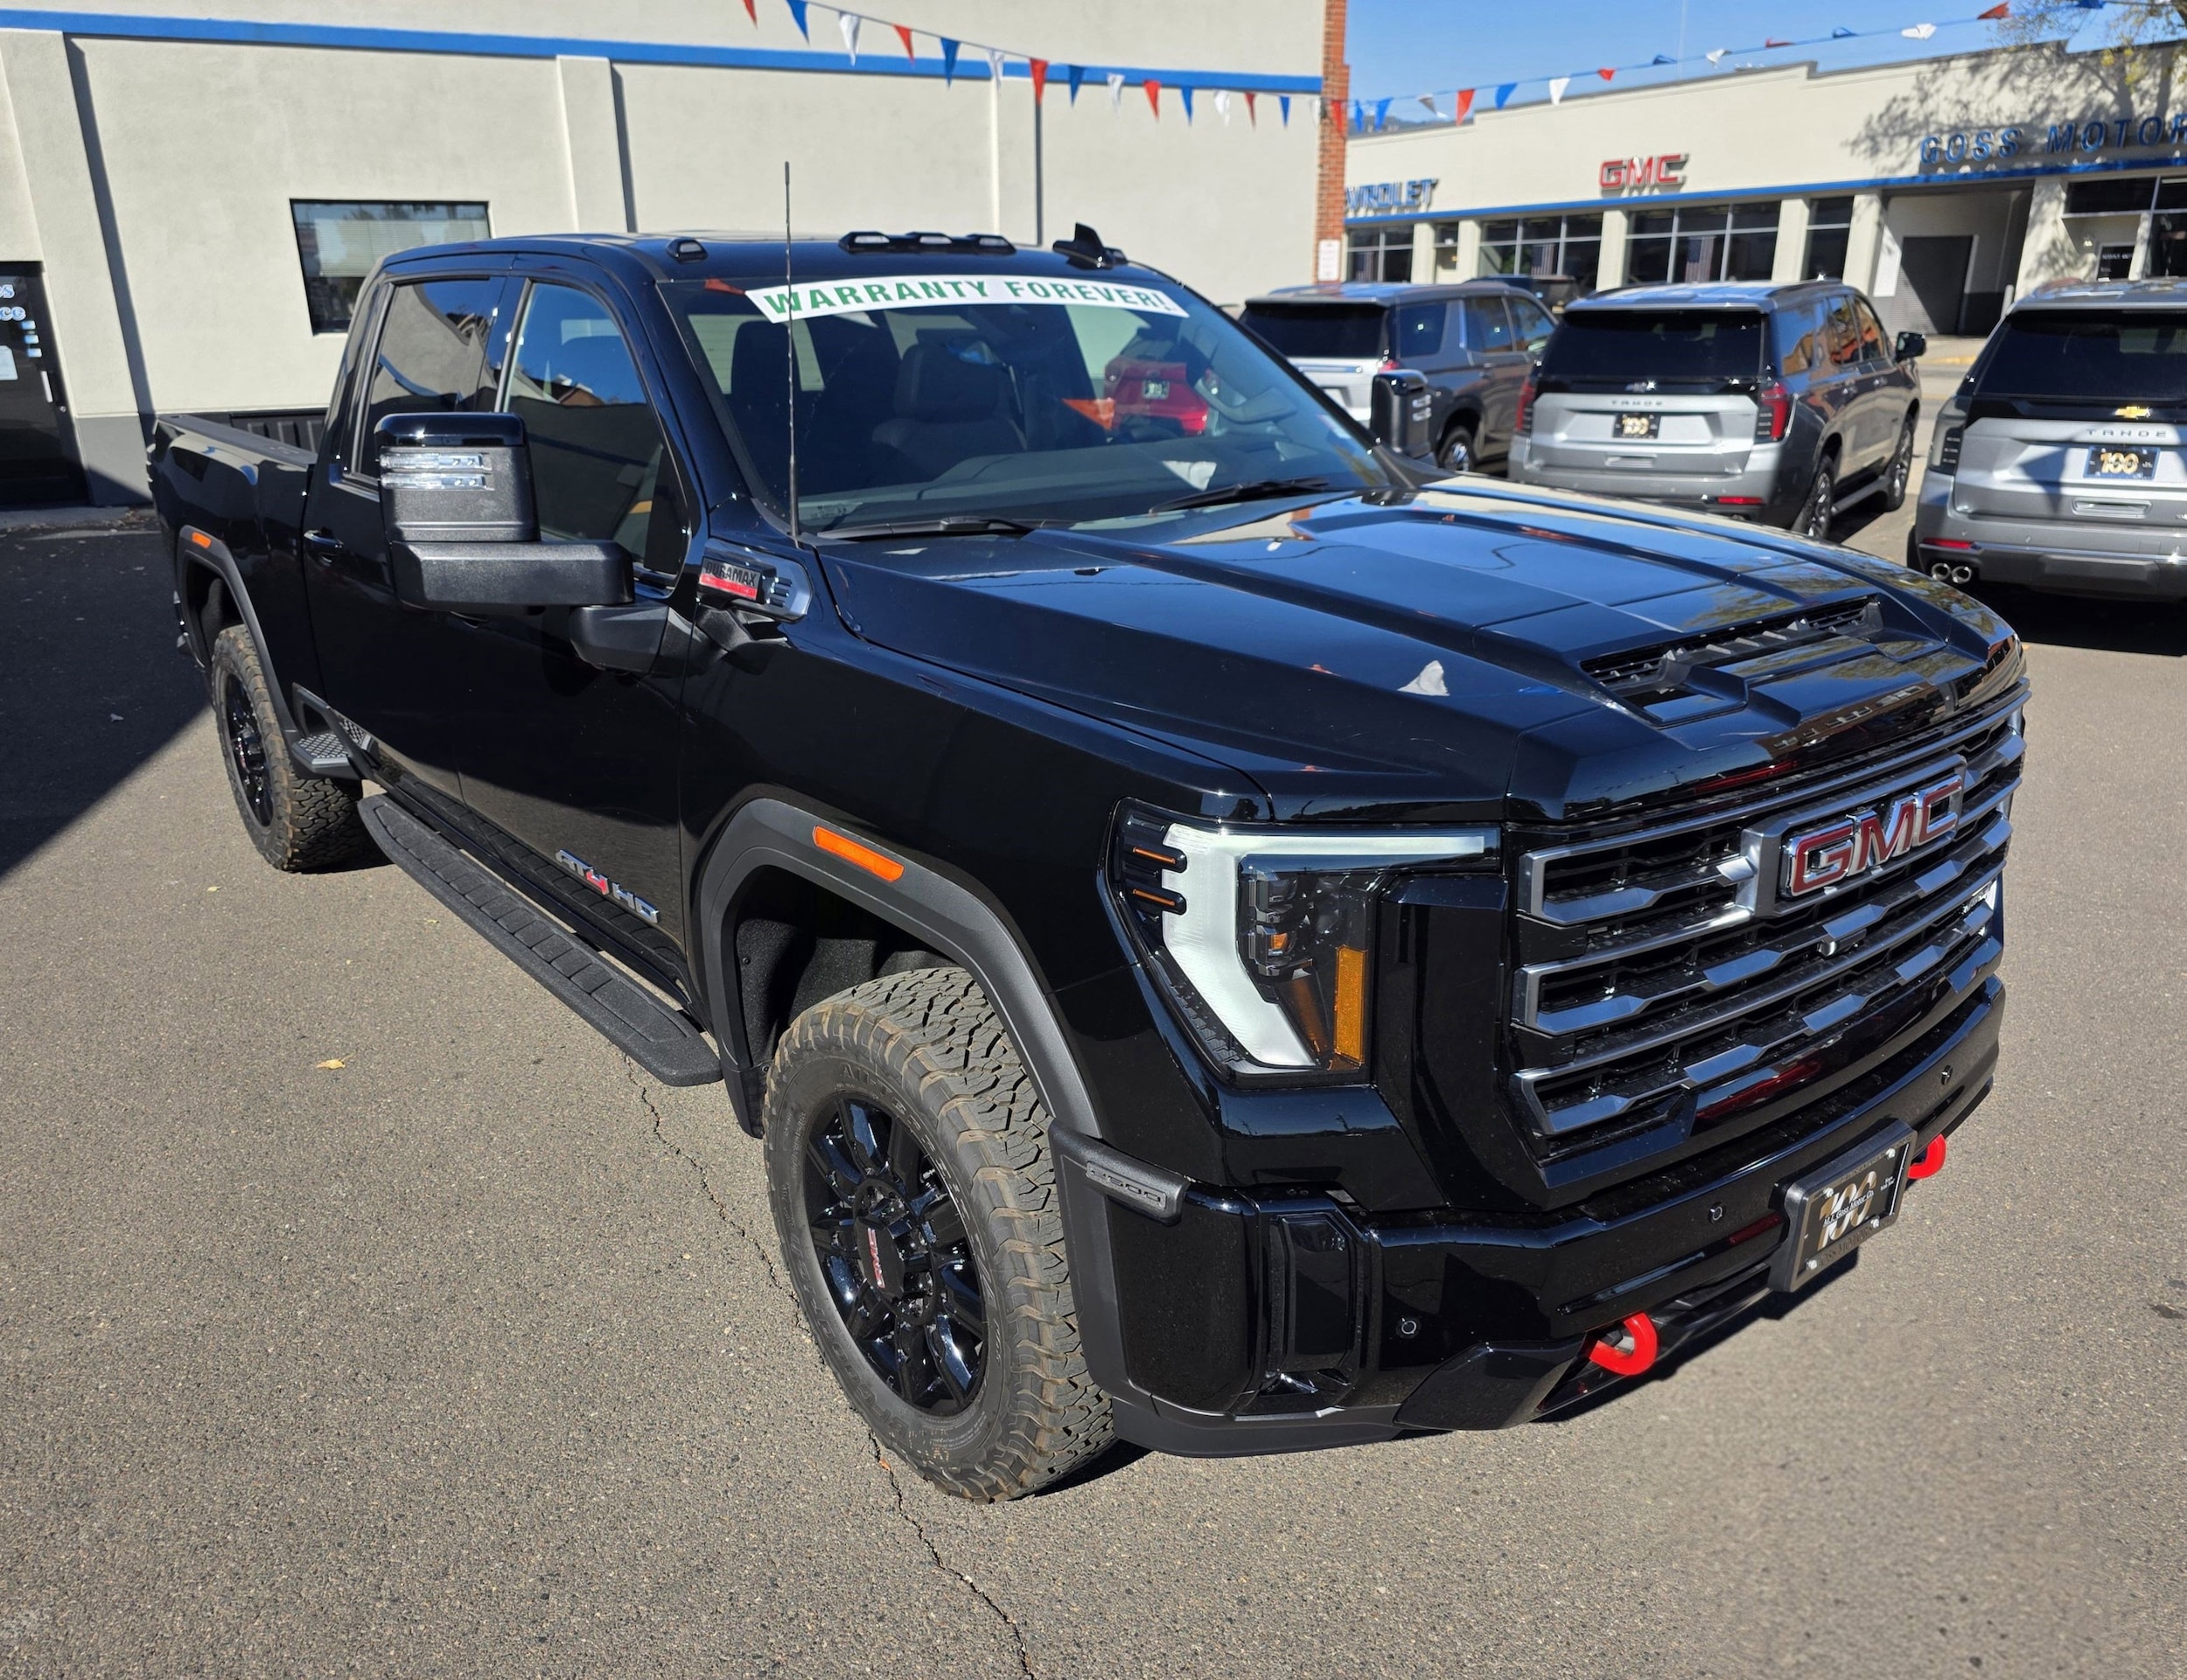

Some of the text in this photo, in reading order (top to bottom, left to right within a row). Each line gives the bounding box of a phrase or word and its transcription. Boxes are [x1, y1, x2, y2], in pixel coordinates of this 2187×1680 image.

[1920, 128, 2021, 164] GOSS
[1599, 153, 1687, 189] GMC
[764, 281, 1172, 314] WARRANTY FOREVER!
[2086, 428, 2166, 438] TAHOE
[2100, 451, 2139, 474] 100
[704, 560, 758, 587] DURAMAX
[1790, 773, 1963, 896] GMC
[555, 848, 658, 924] AT4 HD
[1817, 1171, 1877, 1251] 100
